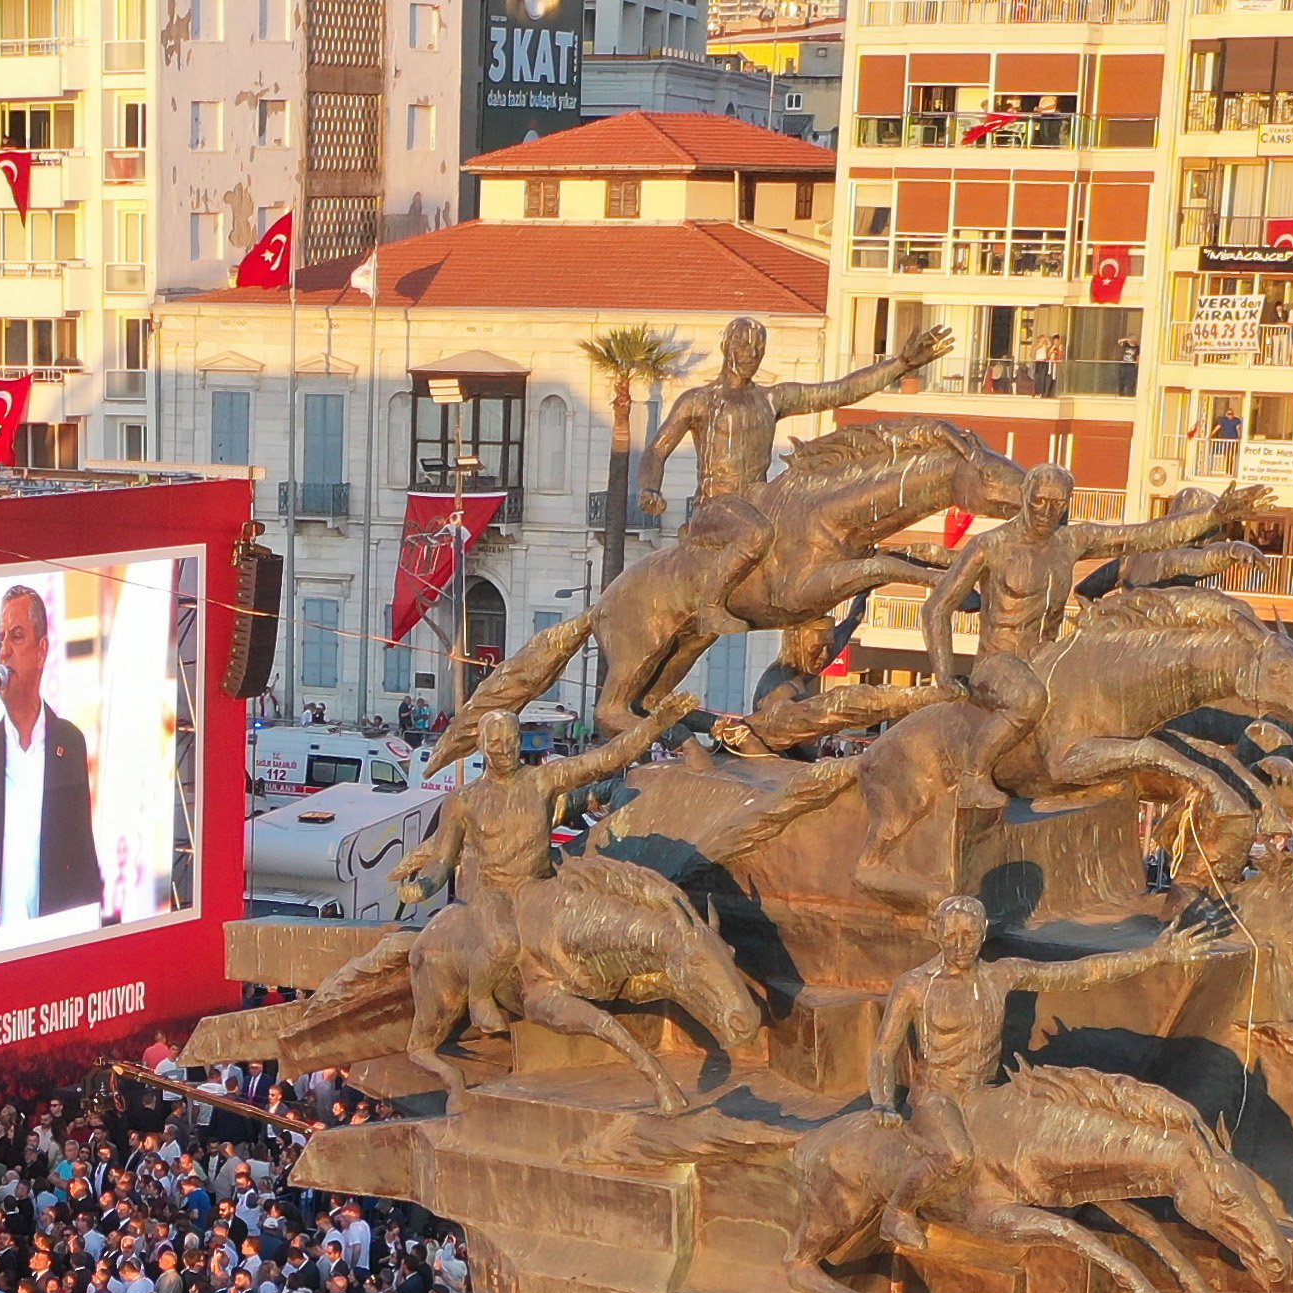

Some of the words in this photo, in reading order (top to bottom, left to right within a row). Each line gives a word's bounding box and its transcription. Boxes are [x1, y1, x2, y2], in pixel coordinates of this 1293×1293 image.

[488, 27, 507, 82] 3
[512, 28, 575, 85] KAT
[487, 89, 506, 107] daha
[558, 92, 577, 112] yıkar
[1194, 322, 1218, 340] 464
[1241, 322, 1257, 339] 55
[266, 768, 287, 781] 112
[39, 996, 84, 1036] SAHİP
[87, 981, 146, 1029] ÇIKIYOR
